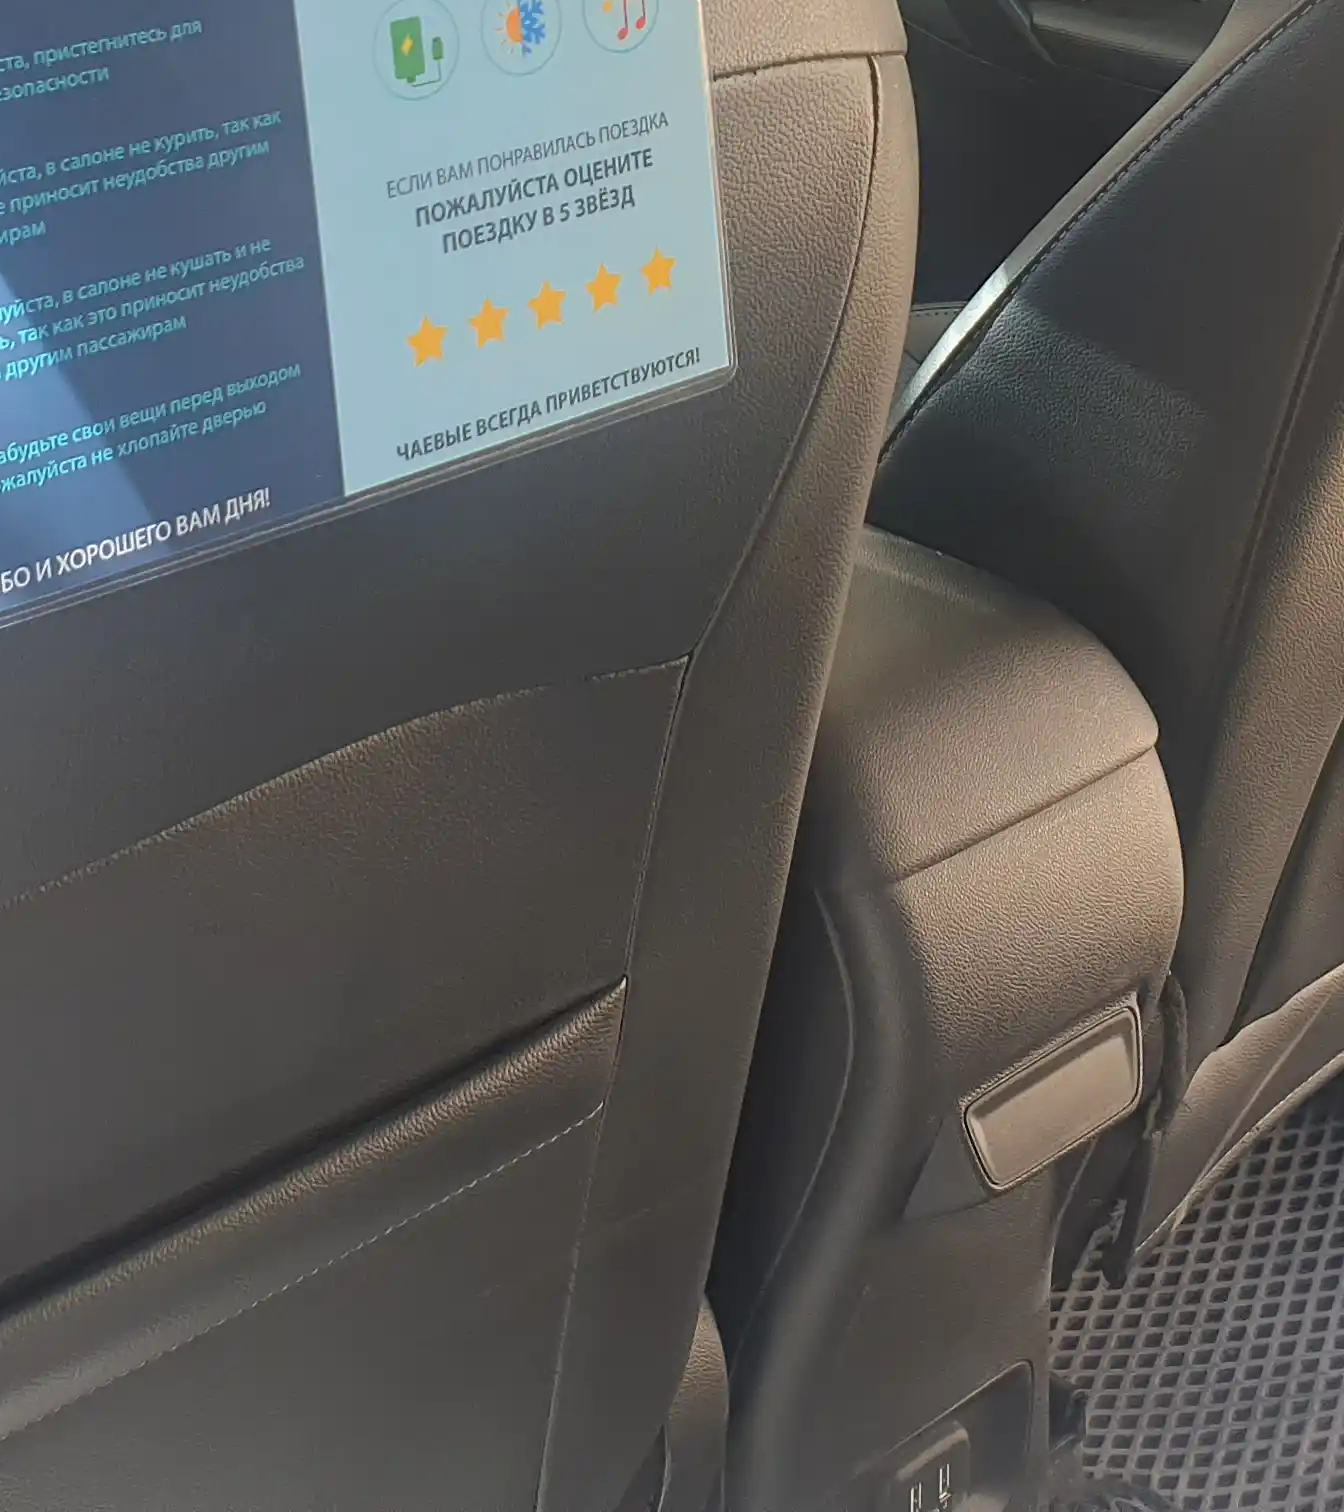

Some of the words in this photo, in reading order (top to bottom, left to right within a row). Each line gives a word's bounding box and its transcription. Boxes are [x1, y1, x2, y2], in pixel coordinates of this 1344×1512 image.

[34, 26, 167, 67] пристегнитесь
[170, 20, 202, 40] для
[10, 183, 99, 216] приносит
[104, 156, 204, 195] неудобства
[208, 141, 269, 172] другим
[46, 162, 56, 176] в
[61, 147, 124, 173] салоне
[130, 139, 150, 156] не
[155, 127, 219, 153] курить,
[223, 118, 249, 134] так
[254, 110, 281, 127] как
[386, 172, 432, 198] ЕСЛИ
[436, 162, 474, 186] ВАМ
[477, 130, 595, 176] ПОНРАВИЛАСЬ
[598, 111, 669, 143] ПОЕЗДКА
[416, 172, 559, 228] ПОЖАЛУЙСТА
[563, 148, 653, 187] ОЦЕНИТЕ
[442, 210, 537, 253] ПОЕЗДКУ
[543, 206, 554, 226] В
[559, 202, 570, 222] 5
[575, 184, 635, 220] ЗВЁЗД
[18, 327, 49, 345] так
[53, 317, 83, 336] как
[87, 308, 116, 326] это
[121, 283, 204, 319] приносит
[208, 256, 304, 293] неудобства
[63, 289, 73, 304] в
[78, 273, 141, 301] салоне
[146, 266, 167, 283] не
[171, 249, 231, 278] кушать
[236, 244, 246, 259] и
[250, 238, 271, 255] не
[5, 346, 73, 378] другим
[77, 316, 187, 357] пассажирам
[72, 418, 115, 443] свои
[119, 403, 166, 431] вещи
[170, 388, 223, 414] перед
[227, 364, 300, 396] выходом
[92, 448, 113, 463] не
[117, 422, 198, 456] хлопайте
[202, 400, 266, 434] дверью
[397, 422, 472, 461] ЧАЕВЫЕ
[476, 400, 542, 435] ВСЕГДА
[546, 347, 701, 412] ПРИВЕТСТВУЮТСЯ!
[36, 558, 52, 583] И
[56, 521, 170, 577] ХОРОШЕГО
[176, 505, 220, 537] ВАМ
[224, 486, 271, 525] ДНЯ!
